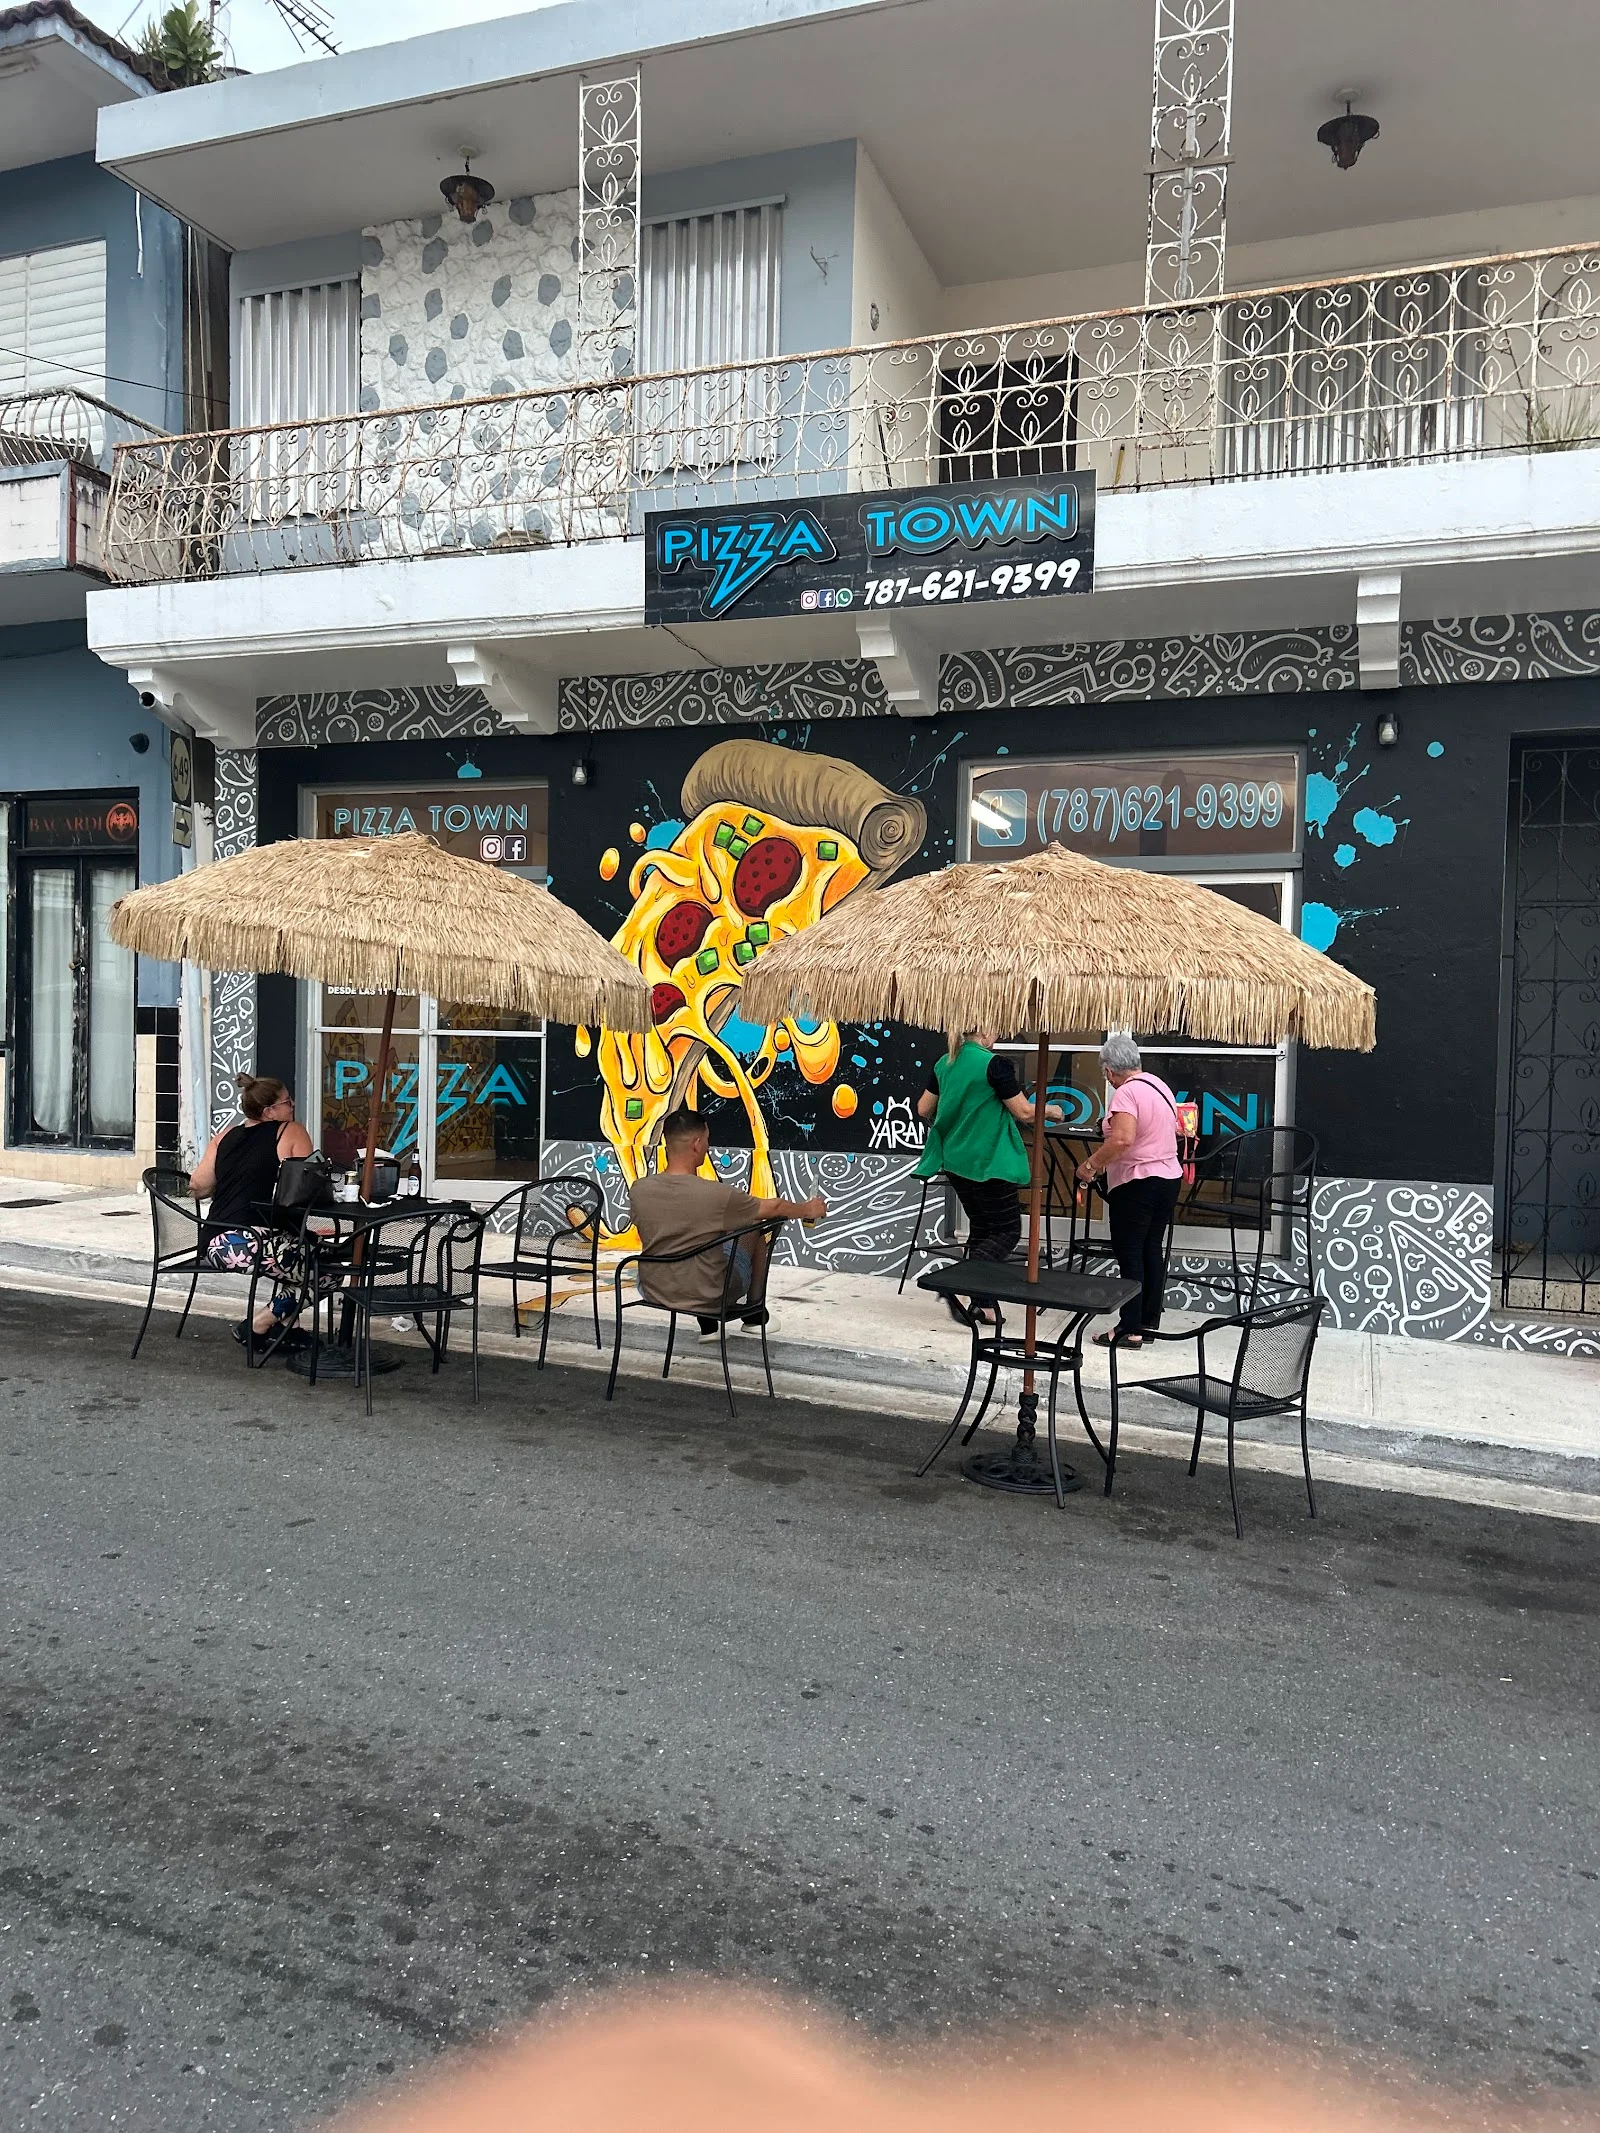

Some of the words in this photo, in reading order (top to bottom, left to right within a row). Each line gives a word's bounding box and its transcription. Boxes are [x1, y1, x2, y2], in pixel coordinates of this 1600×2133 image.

[665, 524, 823, 608] PIZZA
[867, 494, 1068, 548] TOWN
[863, 559, 1081, 606] 787-621-9399
[173, 753, 189, 785] 649
[29, 816, 102, 832] BACARDI
[334, 807, 417, 837] PIZZA
[428, 804, 528, 832] TOWN
[1036, 781, 1284, 844] (787)621-9399
[327, 986, 357, 995] DESDE
